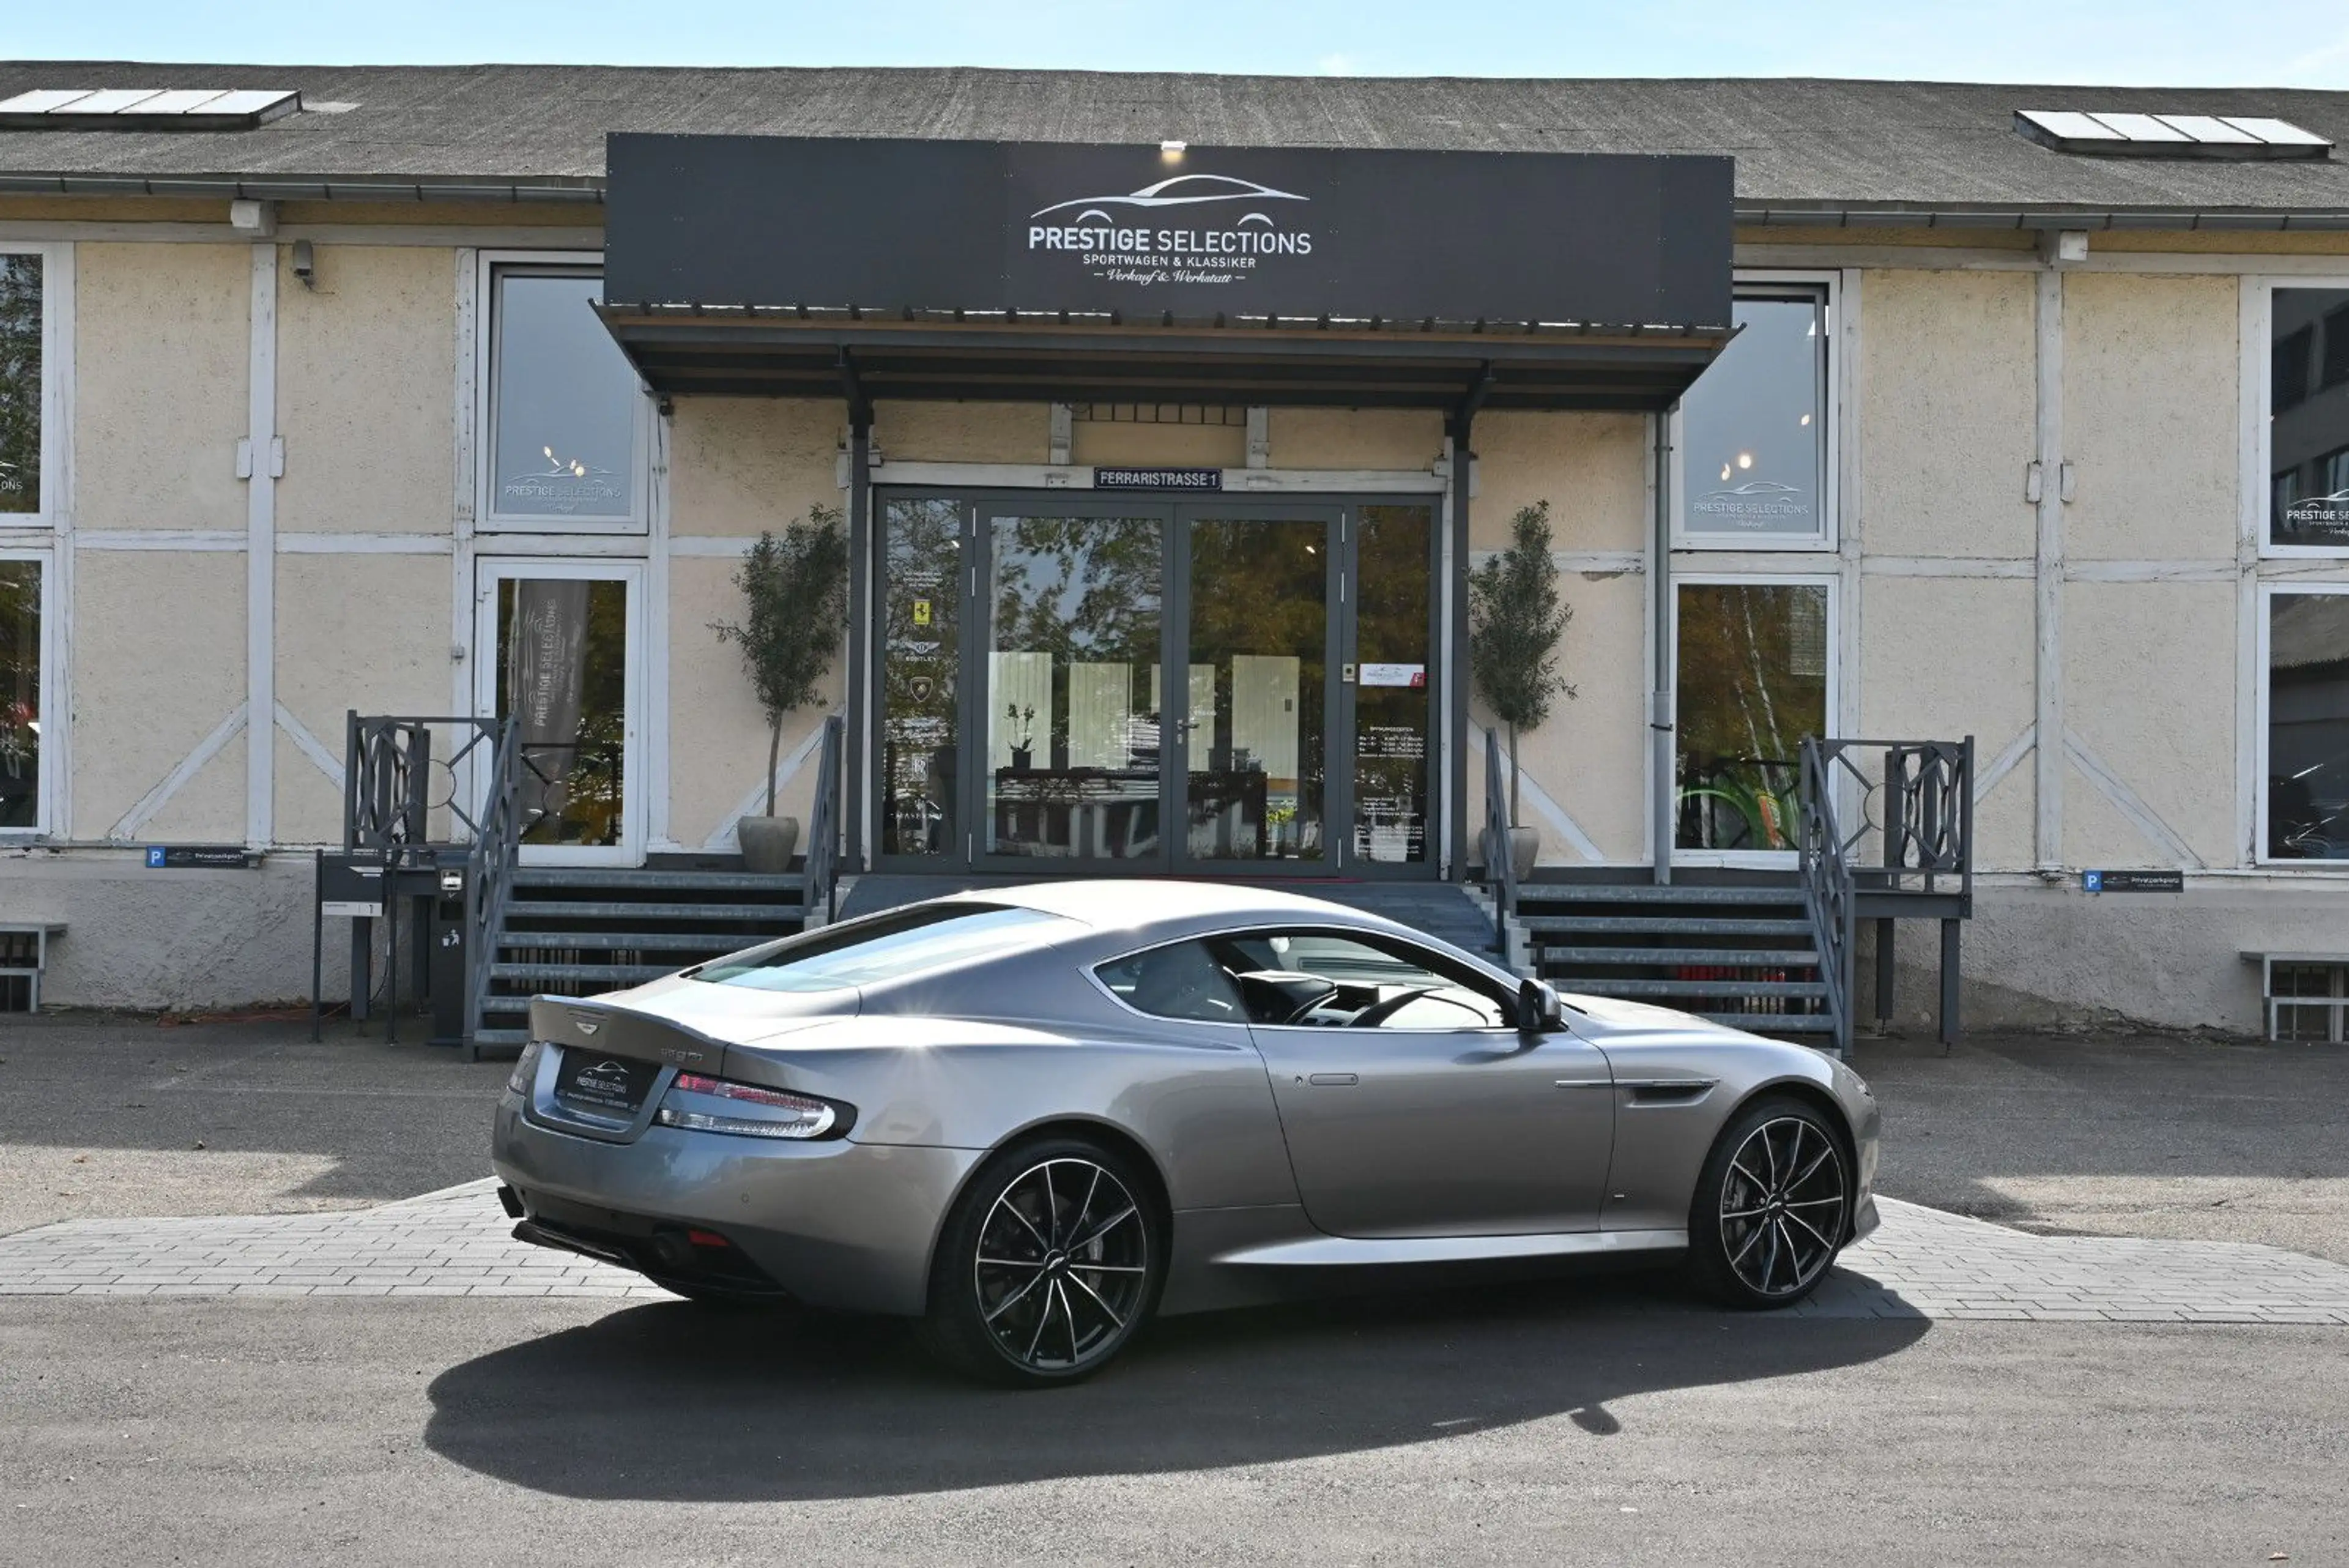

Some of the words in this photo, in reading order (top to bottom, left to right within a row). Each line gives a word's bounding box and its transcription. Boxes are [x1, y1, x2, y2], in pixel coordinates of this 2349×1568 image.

[1029, 227, 1150, 250] PRESTIGE
[1157, 230, 1312, 255] SELECTIONS
[1083, 255, 1168, 267] SPORTWAGEN
[1173, 257, 1181, 267] &
[1187, 256, 1256, 268] KLASSIKER
[1107, 269, 1159, 285] Verkauf
[1158, 272, 1169, 282] &
[1173, 270, 1232, 284] Werkstatt
[1100, 471, 1208, 486] FERRARISTRASSE
[1211, 474, 1216, 486] 1
[505, 486, 554, 496] PRESTIGE
[1694, 503, 1743, 513] PRESTIGE
[1745, 505, 1808, 515] SELECTIONS
[2287, 510, 2336, 520] PRESTIGE
[151, 851, 161, 863] P
[2088, 875, 2098, 887] P
